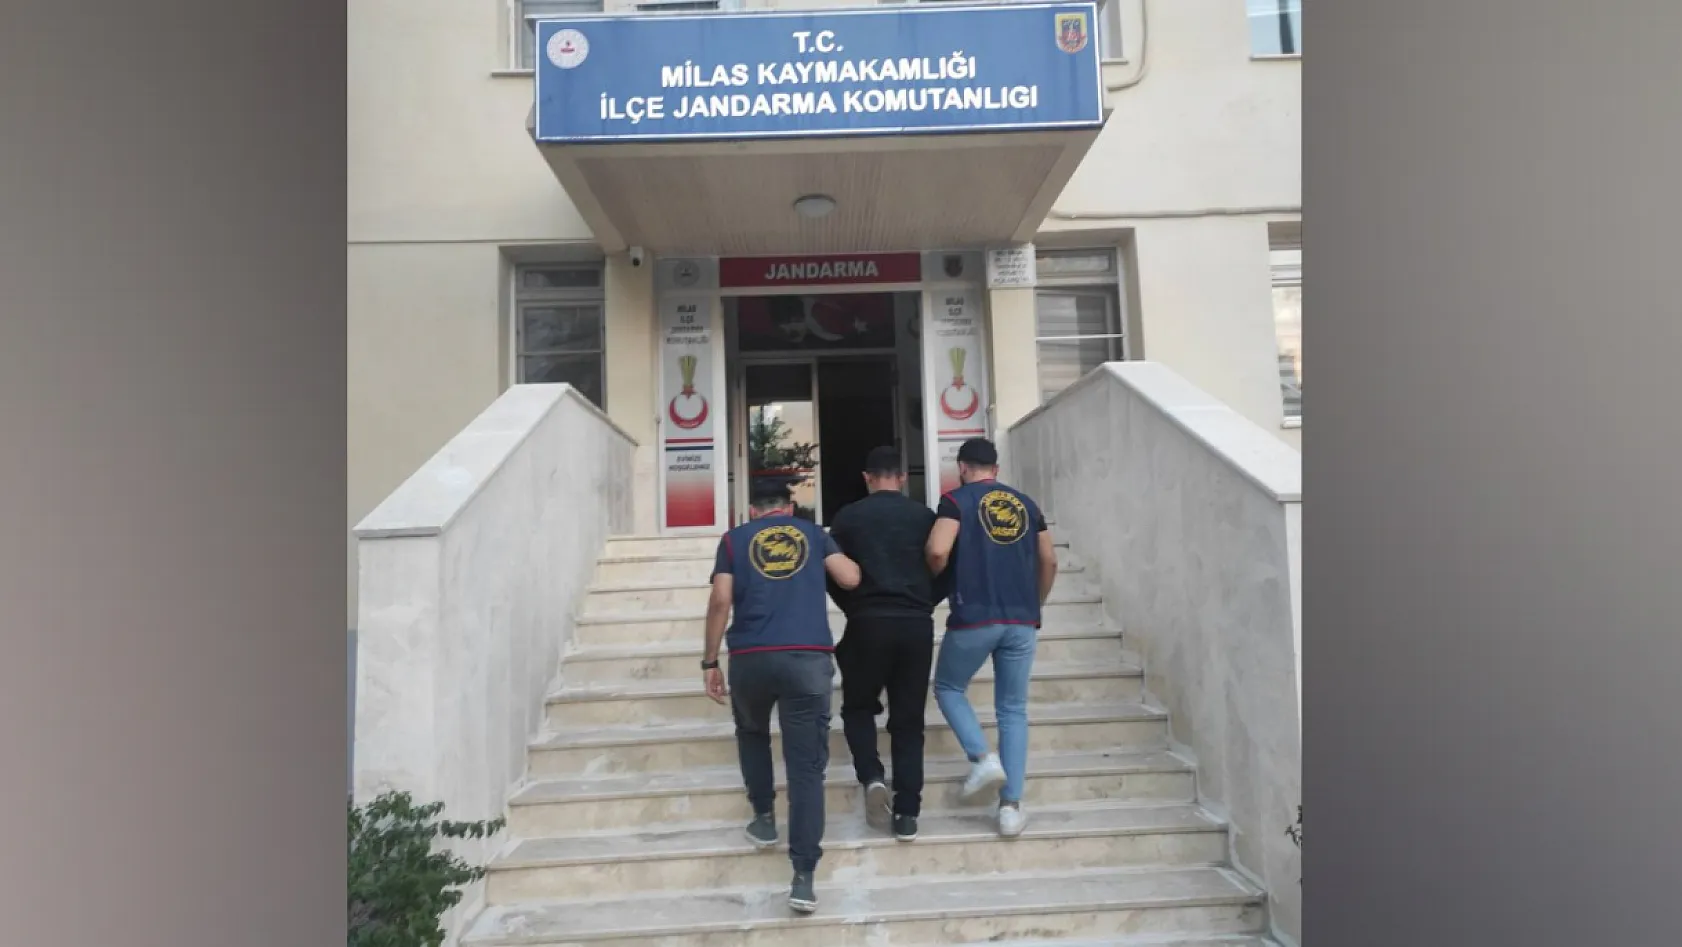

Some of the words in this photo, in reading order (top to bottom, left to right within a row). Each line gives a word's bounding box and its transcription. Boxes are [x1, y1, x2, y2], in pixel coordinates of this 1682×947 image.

[793, 30, 844, 53] T.C.
[661, 60, 749, 88] MİLAS
[757, 50, 976, 86] KAYMAKAMLIĞI
[600, 91, 666, 124] İLÇE
[673, 91, 838, 119] JANDARMA
[764, 260, 879, 280] JANDARMA
